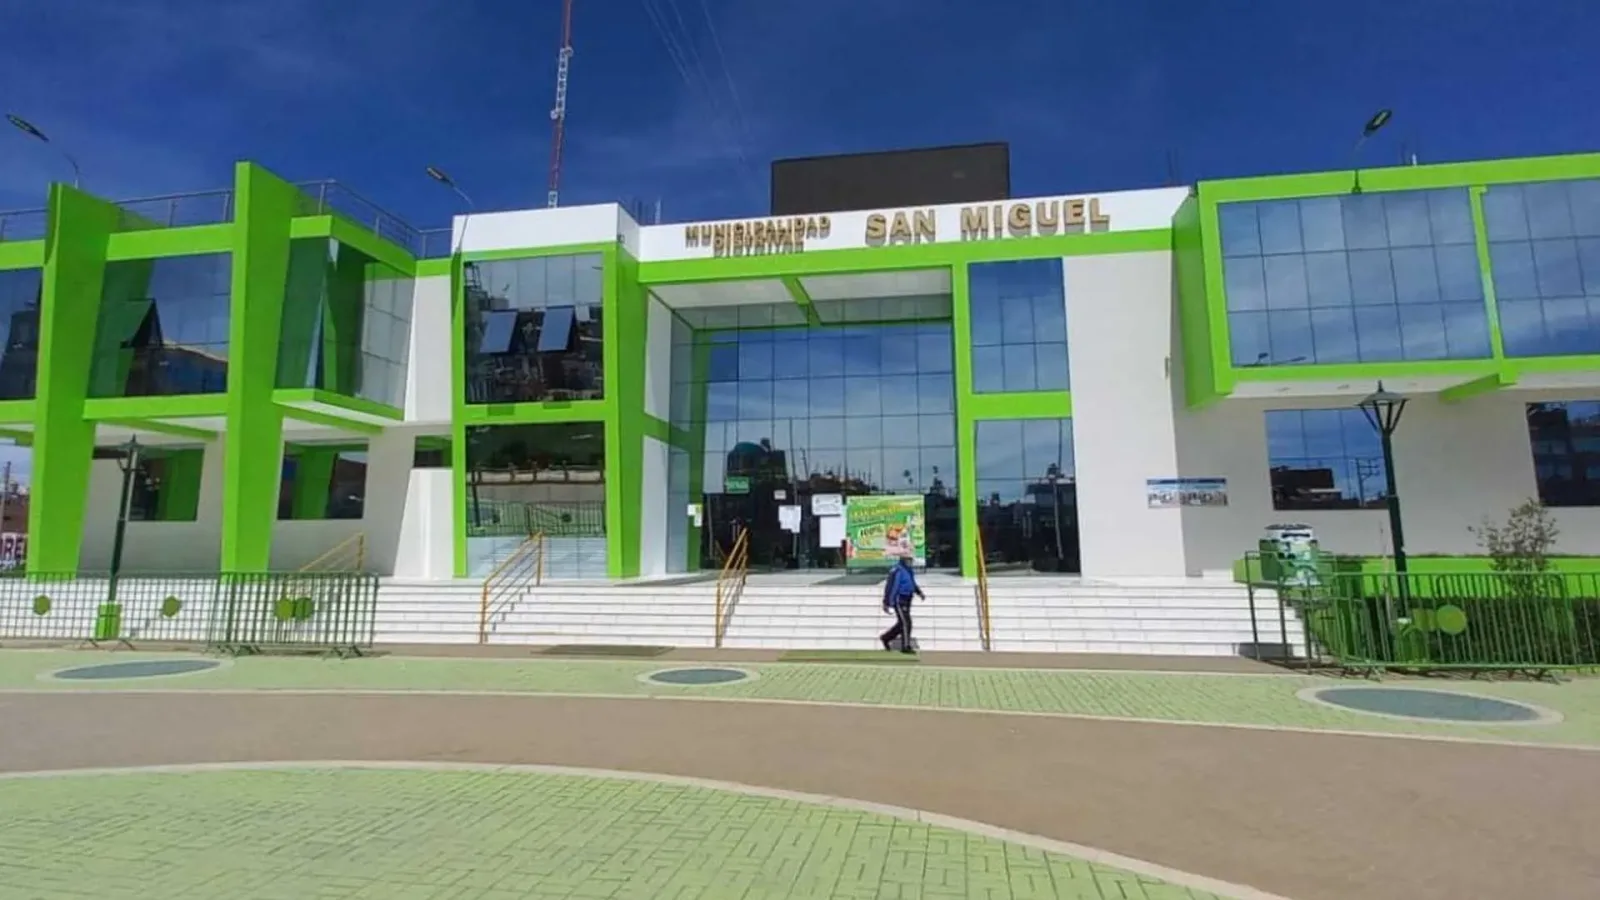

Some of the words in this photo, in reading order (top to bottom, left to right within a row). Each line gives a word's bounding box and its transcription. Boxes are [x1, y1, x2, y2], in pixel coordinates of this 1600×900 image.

[685, 215, 831, 243] MUNICIPALIDAD
[866, 209, 936, 241] SAN
[960, 198, 1111, 235] MIGUEL
